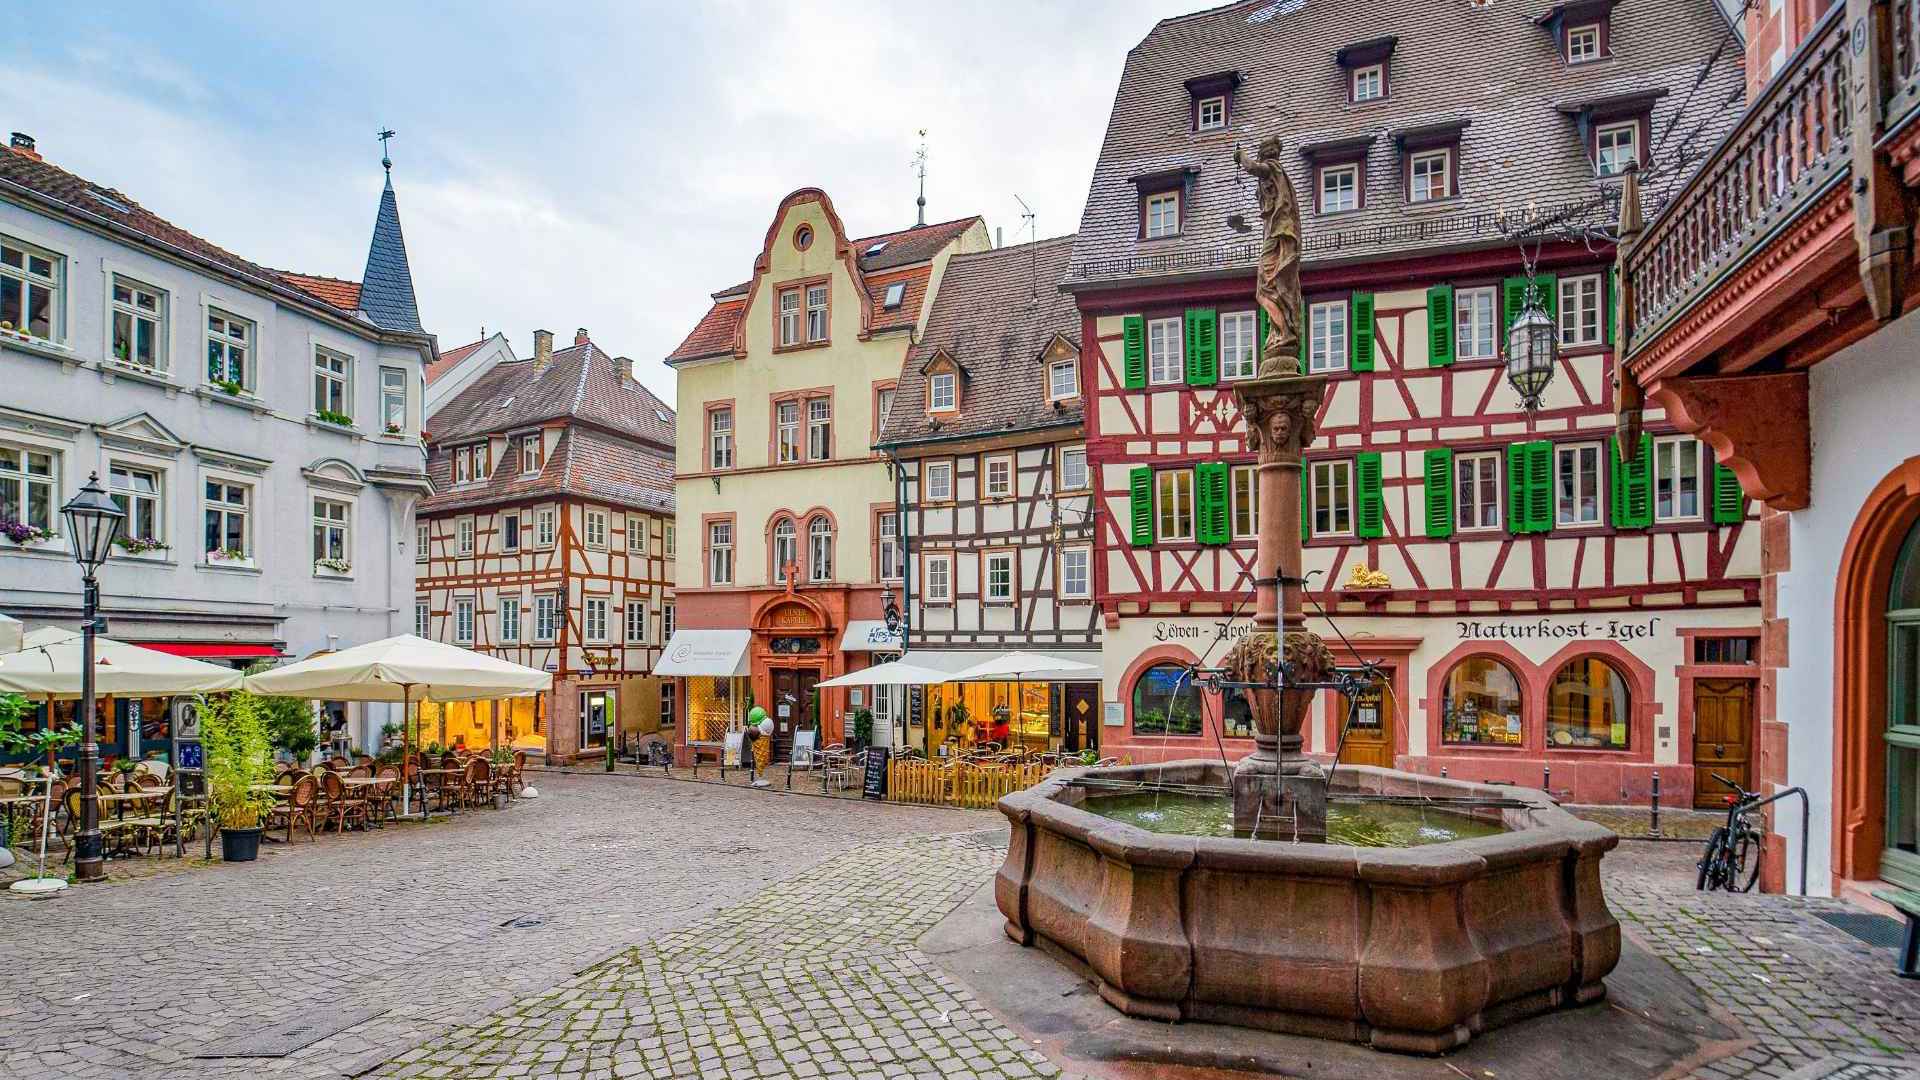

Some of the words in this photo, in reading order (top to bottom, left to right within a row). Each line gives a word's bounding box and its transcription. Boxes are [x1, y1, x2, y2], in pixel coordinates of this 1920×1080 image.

[1152, 622, 1199, 641] Löwen
[1456, 619, 1590, 639] Naturkost
[1607, 618, 1661, 642] Igel
